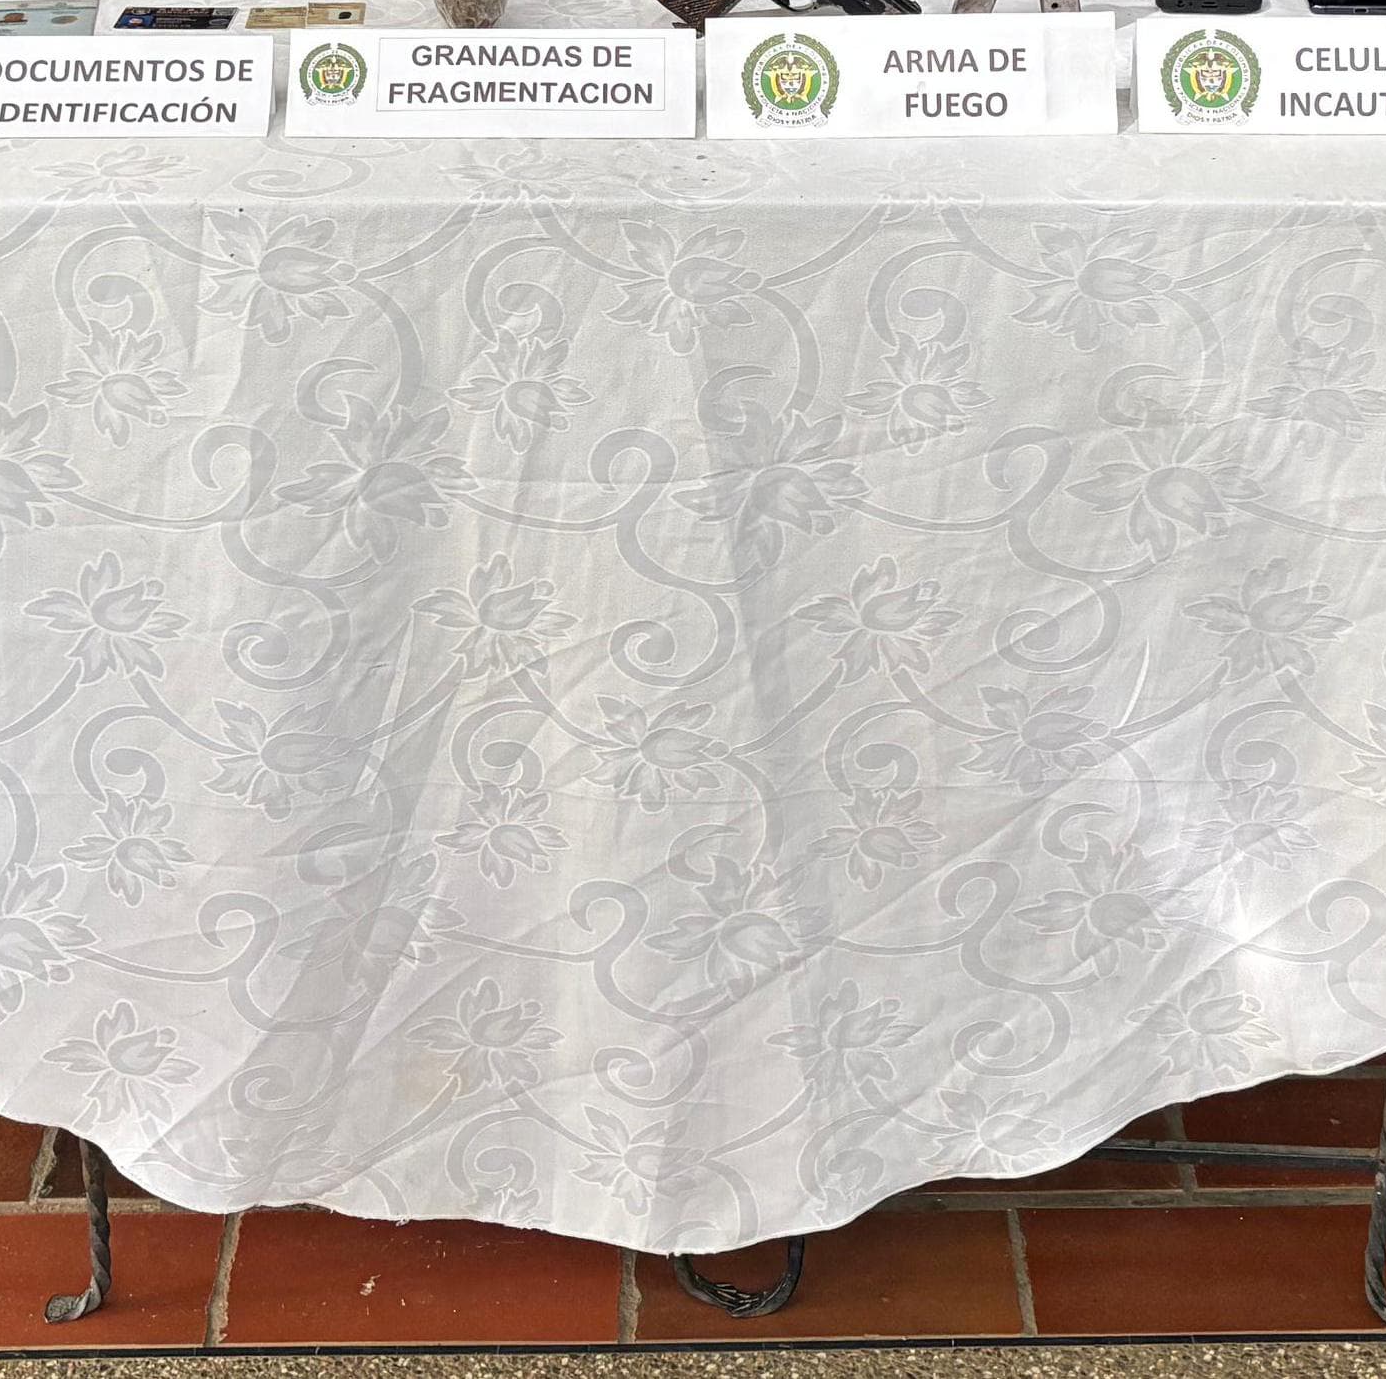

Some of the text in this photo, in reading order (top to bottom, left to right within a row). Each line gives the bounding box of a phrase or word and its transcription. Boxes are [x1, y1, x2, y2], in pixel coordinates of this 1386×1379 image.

[411, 45, 632, 69] GRANADAS DE
[883, 48, 1028, 73] ARMA DE
[215, 59, 253, 82] DE
[389, 82, 654, 105] FRAGMENTACION
[905, 92, 1008, 117] FUEGO
